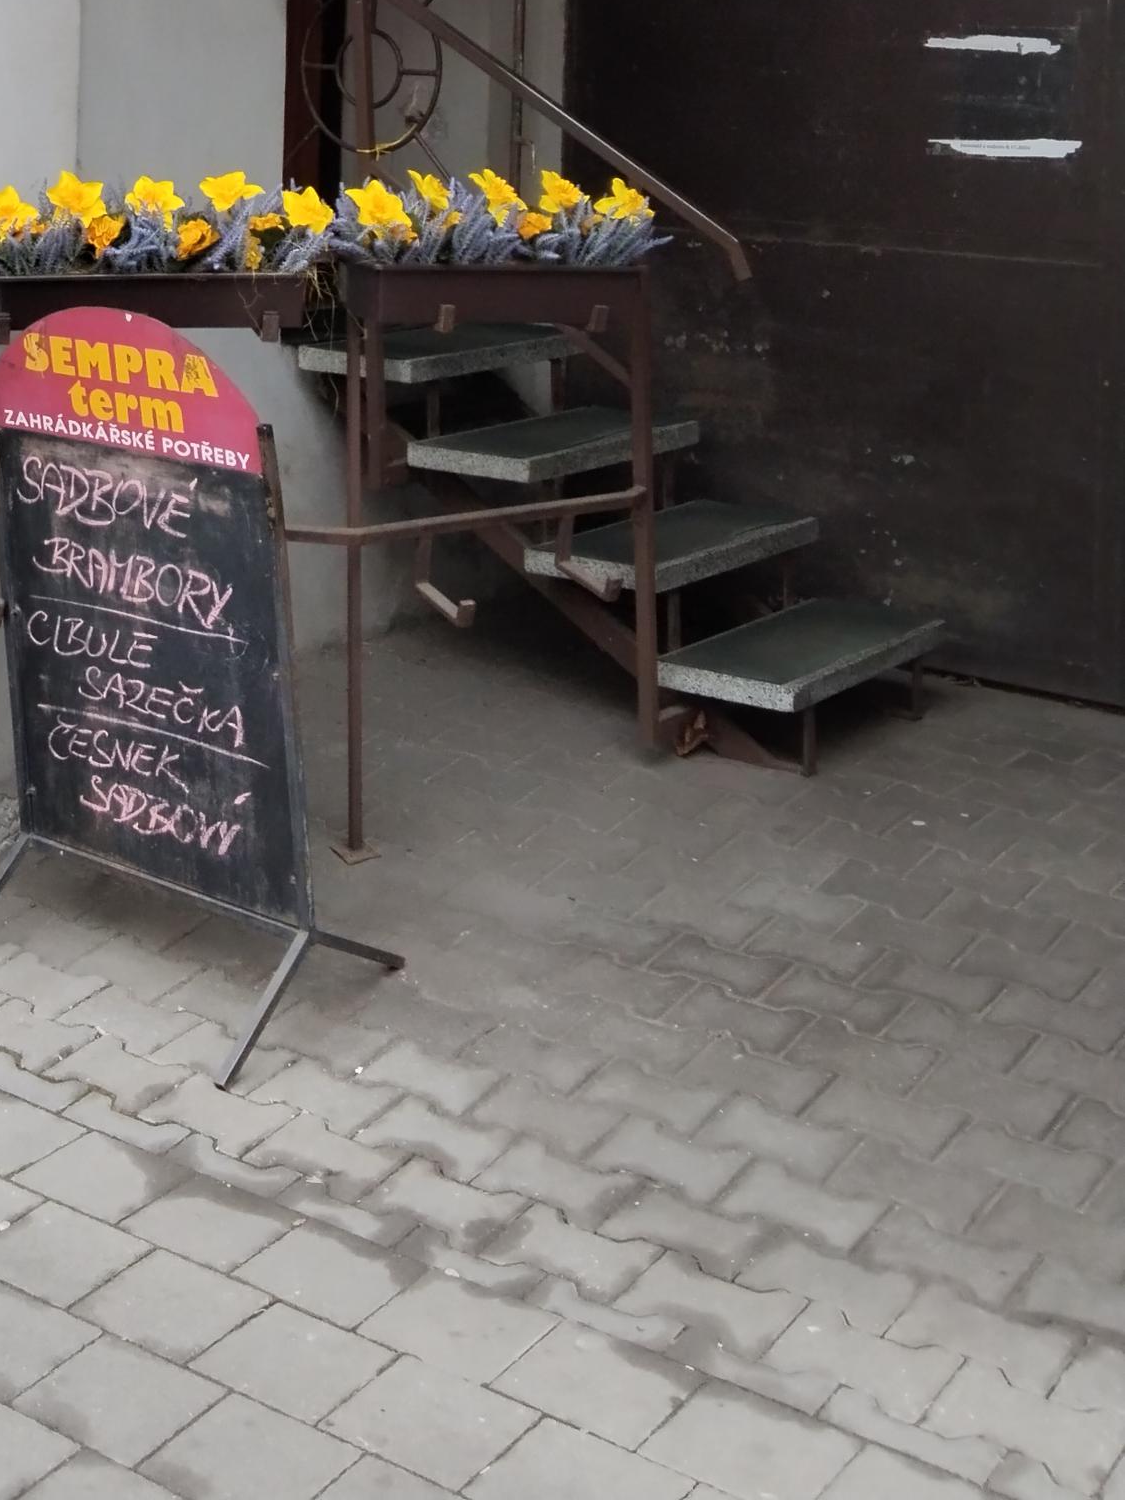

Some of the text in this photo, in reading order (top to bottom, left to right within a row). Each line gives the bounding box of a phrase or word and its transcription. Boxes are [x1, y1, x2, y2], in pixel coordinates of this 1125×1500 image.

[23, 332, 219, 397] SEMPRA
[4, 409, 250, 470] ZAHRÁDKÁŘSKÉ POTŘEBY
[68, 380, 184, 433] term
[17, 456, 198, 538] SADBOVÉ
[33, 537, 233, 629] BRAMBORY
[27, 610, 158, 668] CIBULE
[78, 666, 245, 748] SAZEČKA
[48, 714, 189, 794] ČESNEK
[80, 775, 251, 855] SADBOVÝ
